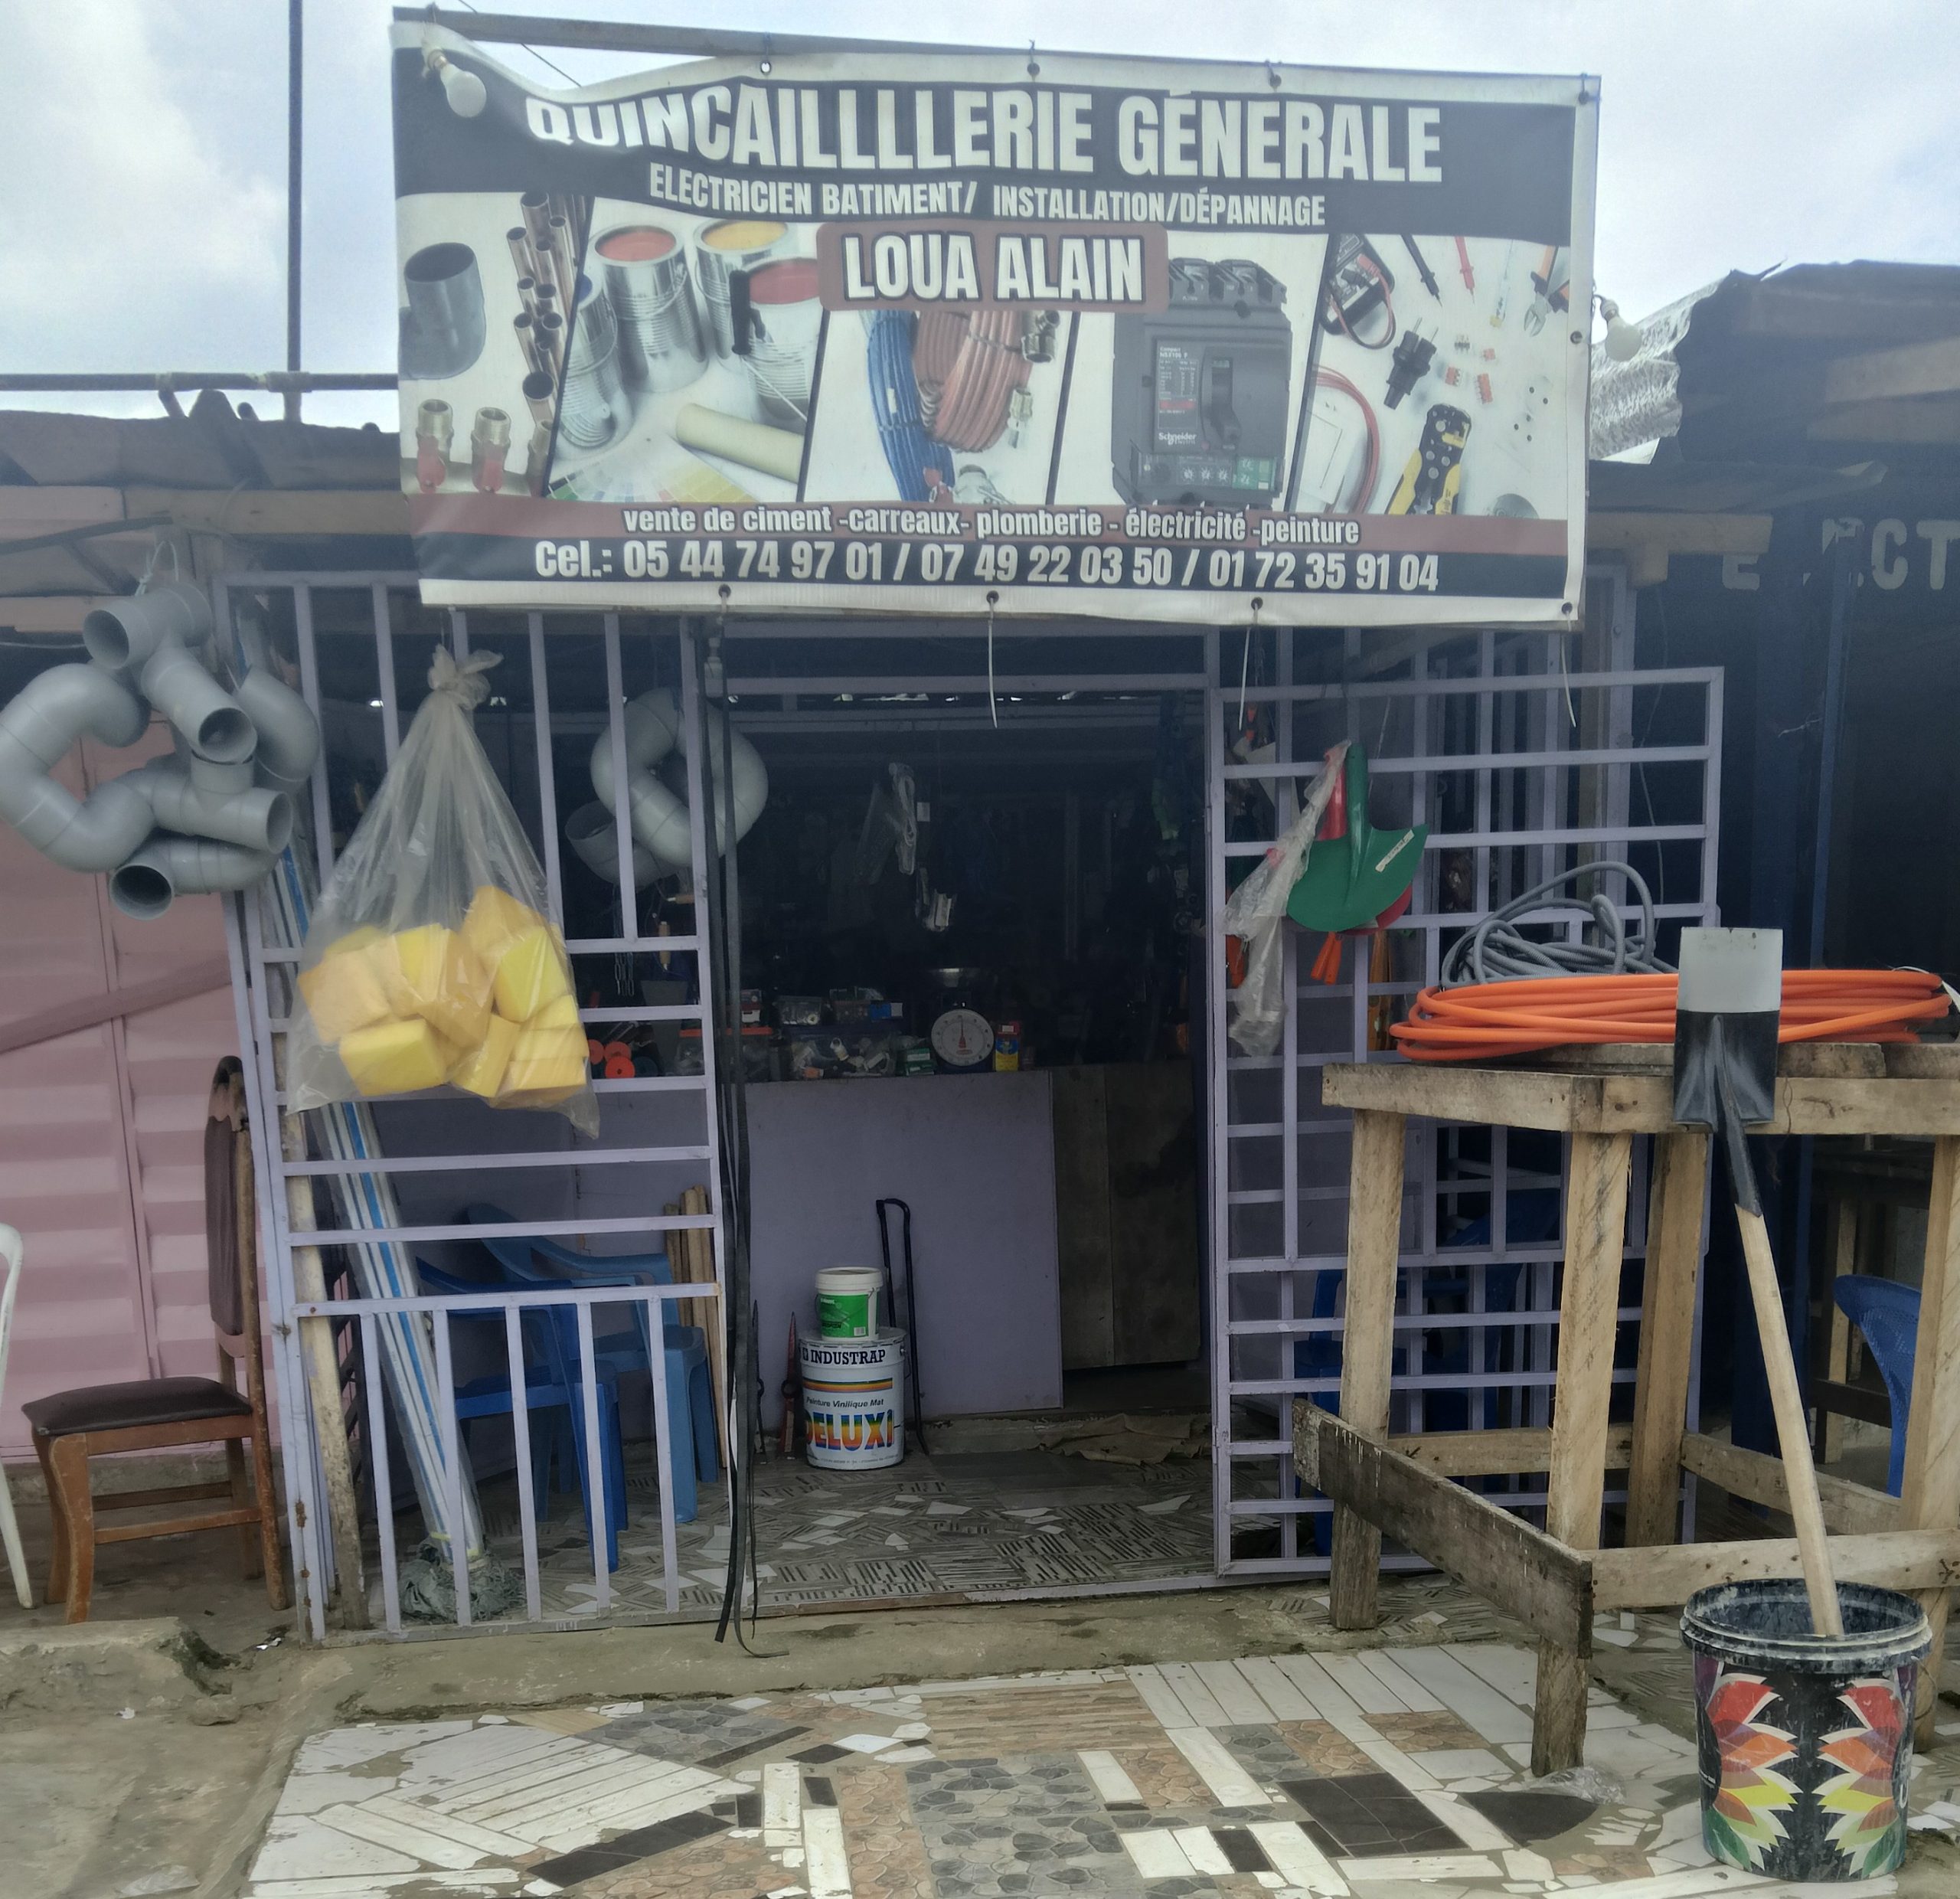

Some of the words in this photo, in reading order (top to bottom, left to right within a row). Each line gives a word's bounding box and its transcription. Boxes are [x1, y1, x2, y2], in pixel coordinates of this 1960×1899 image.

[526, 83, 1093, 172] QUINCAILLLLERIE
[650, 162, 812, 215] ELECTRICIEN
[822, 181, 977, 214] BATIMENT/
[844, 234, 979, 299] LOUA
[997, 237, 1142, 301] ALAIN
[623, 507, 696, 531] vente
[704, 507, 735, 531] de
[743, 506, 832, 531] ciment
[976, 509, 1102, 539] plomberie
[1125, 510, 1246, 541] électricité
[622, 540, 669, 577] 05
[679, 540, 725, 577] 44
[735, 540, 780, 578] 74
[791, 541, 835, 579] 97
[846, 541, 882, 580] 01
[921, 543, 965, 581] 07
[974, 544, 1018, 581] 49
[1027, 544, 1071, 583] 22
[1080, 545, 1123, 584] 03
[1132, 547, 1172, 586] 50
[1209, 549, 1245, 587] 01
[1255, 551, 1296, 588] 72
[1305, 551, 1346, 590] 35
[1356, 552, 1390, 590] 91
[1399, 554, 1439, 591] 04
[811, 1349, 886, 1365] INDUSTRAP
